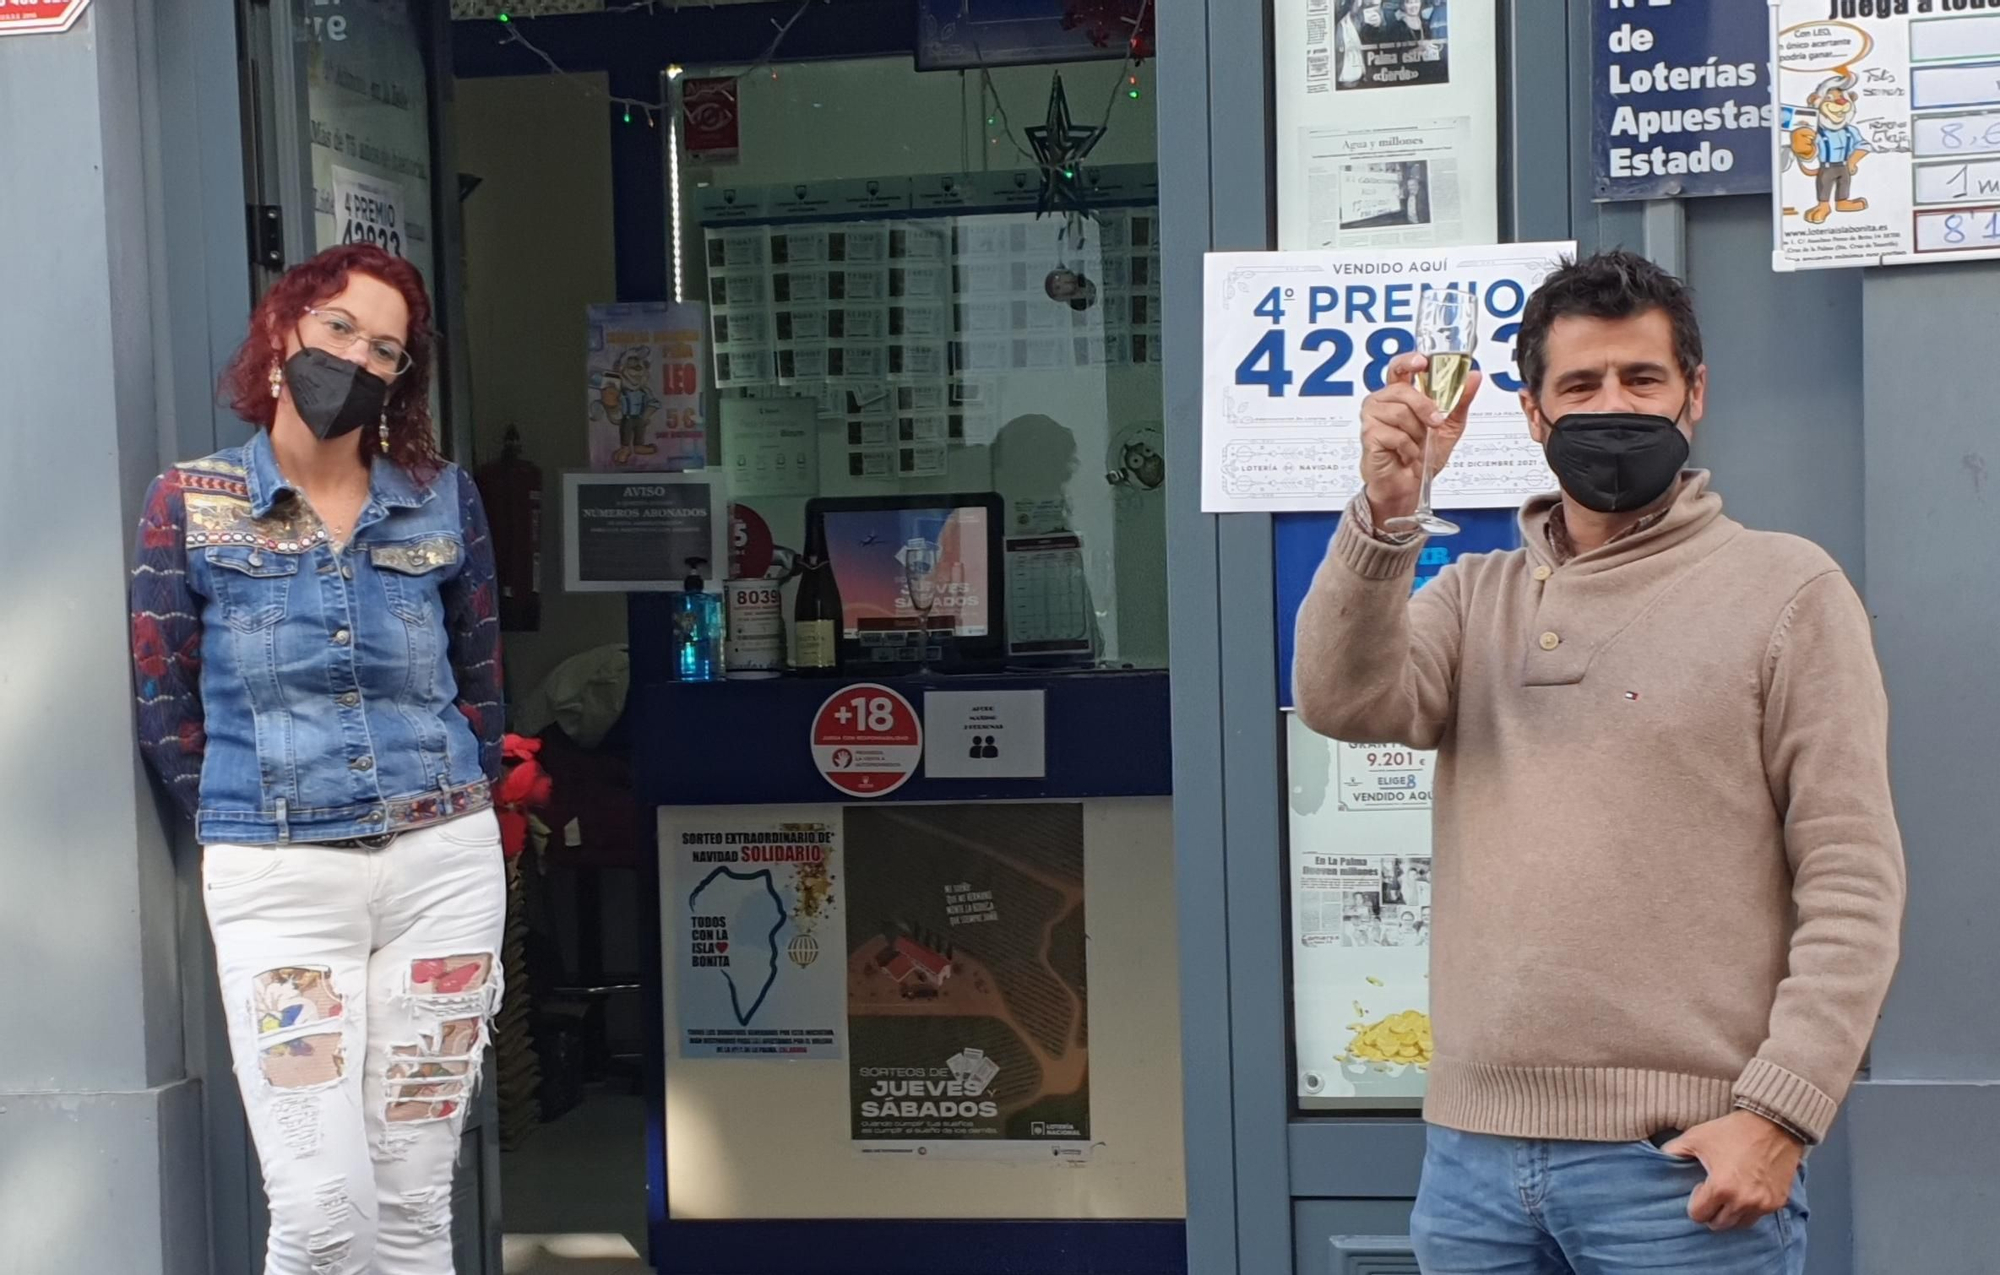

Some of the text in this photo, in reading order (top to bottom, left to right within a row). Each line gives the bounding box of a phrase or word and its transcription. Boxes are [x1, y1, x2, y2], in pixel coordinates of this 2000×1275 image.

[1609, 24, 1654, 53] de
[1811, 39, 1851, 48] acertante
[1367, 51, 1398, 66] Palma
[1610, 57, 1756, 94] Loterías
[1611, 100, 1771, 142] Apuestas
[1343, 136, 1423, 152] Agua y millones
[1610, 142, 1733, 178] Estado
[354, 194, 395, 229] PREMIO
[1333, 258, 1447, 275] VENDIDO AQUÍ
[663, 362, 697, 396] LEO
[1241, 463, 1338, 472] LOTERÍA NAVIDAD
[622, 486, 666, 498] AVISO
[642, 507, 708, 518] ABONADOS
[834, 696, 894, 732] +18
[1367, 752, 1426, 767] 9.201 €
[1353, 790, 1434, 802] VENDIDO AQU
[682, 832, 722, 845] SORTEO
[725, 831, 815, 844] EXTRAORDINARIO
[693, 845, 821, 863] NAVIDAD SOLIDARIO
[1315, 856, 1367, 866] En La Palma
[691, 916, 726, 928] TODOS
[692, 929, 729, 941] CON LA
[692, 942, 715, 954] ISLA
[692, 955, 730, 967] BONITA
[860, 1067, 948, 1078] SORTEOS DE
[870, 1080, 998, 1099] JUEVES Y
[861, 1096, 998, 1118] SÁBADOS
